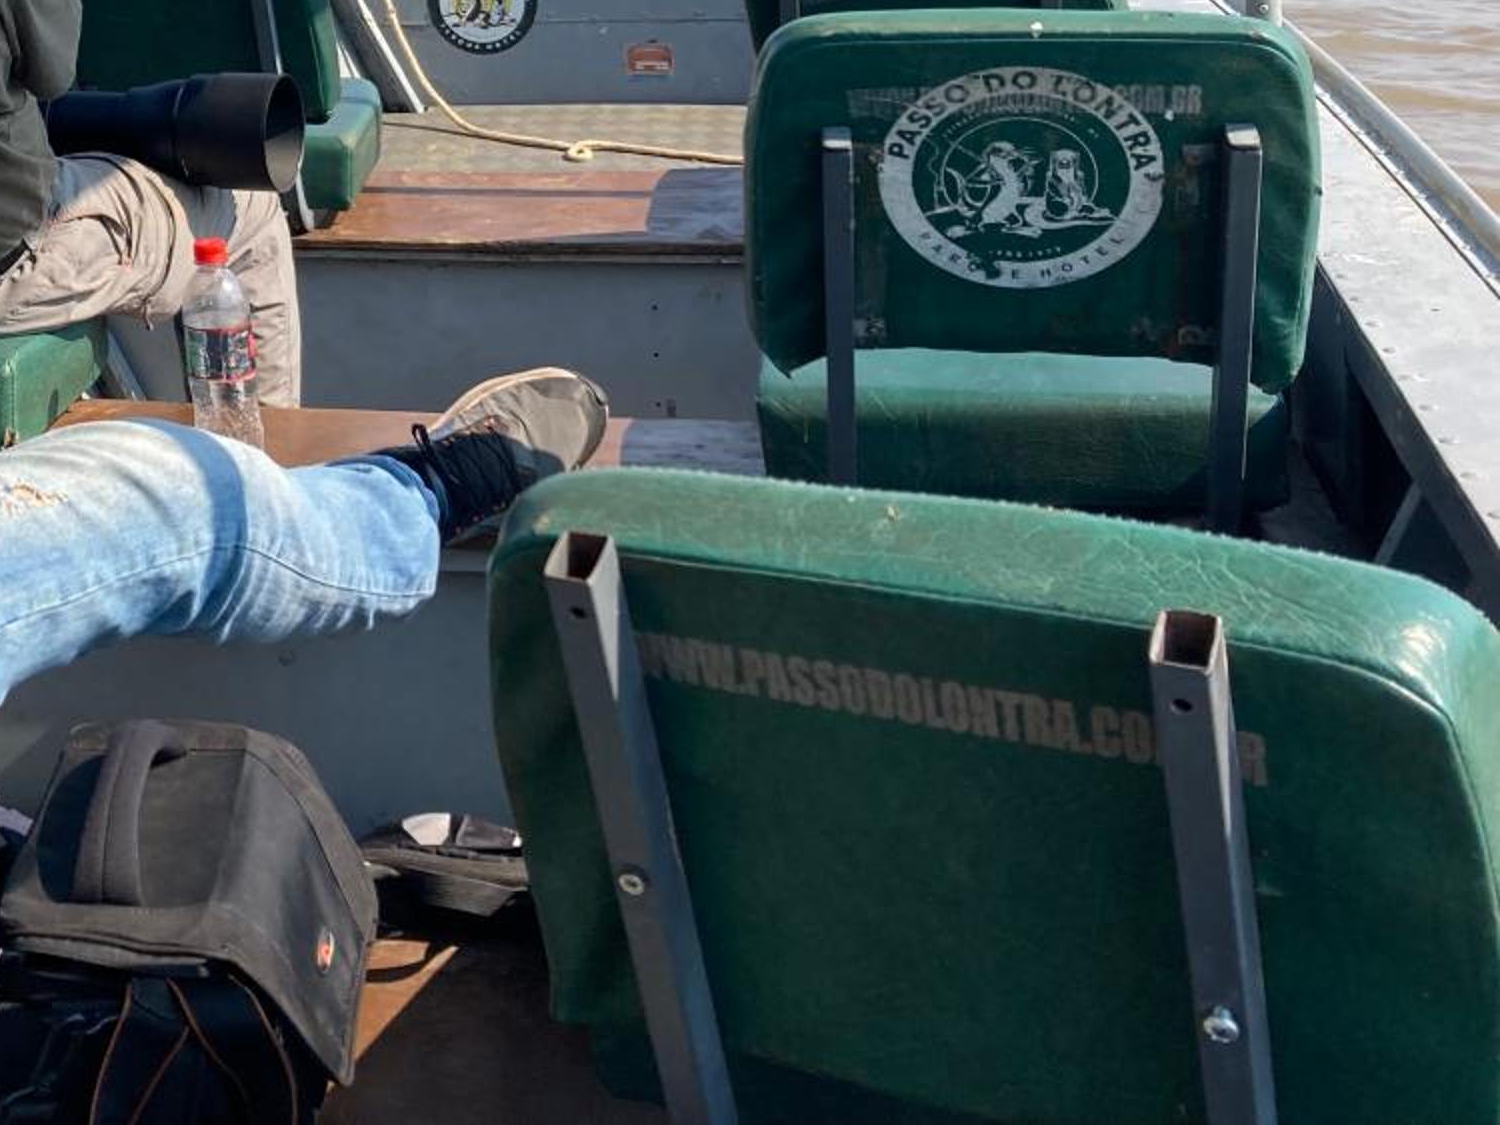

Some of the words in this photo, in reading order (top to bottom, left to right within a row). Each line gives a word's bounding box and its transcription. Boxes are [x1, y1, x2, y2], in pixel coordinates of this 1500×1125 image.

[887, 82, 969, 159] PASSO
[980, 70, 1037, 95] DO
[1052, 78, 1158, 172] LONTRA
[920, 231, 1020, 281] PARQE
